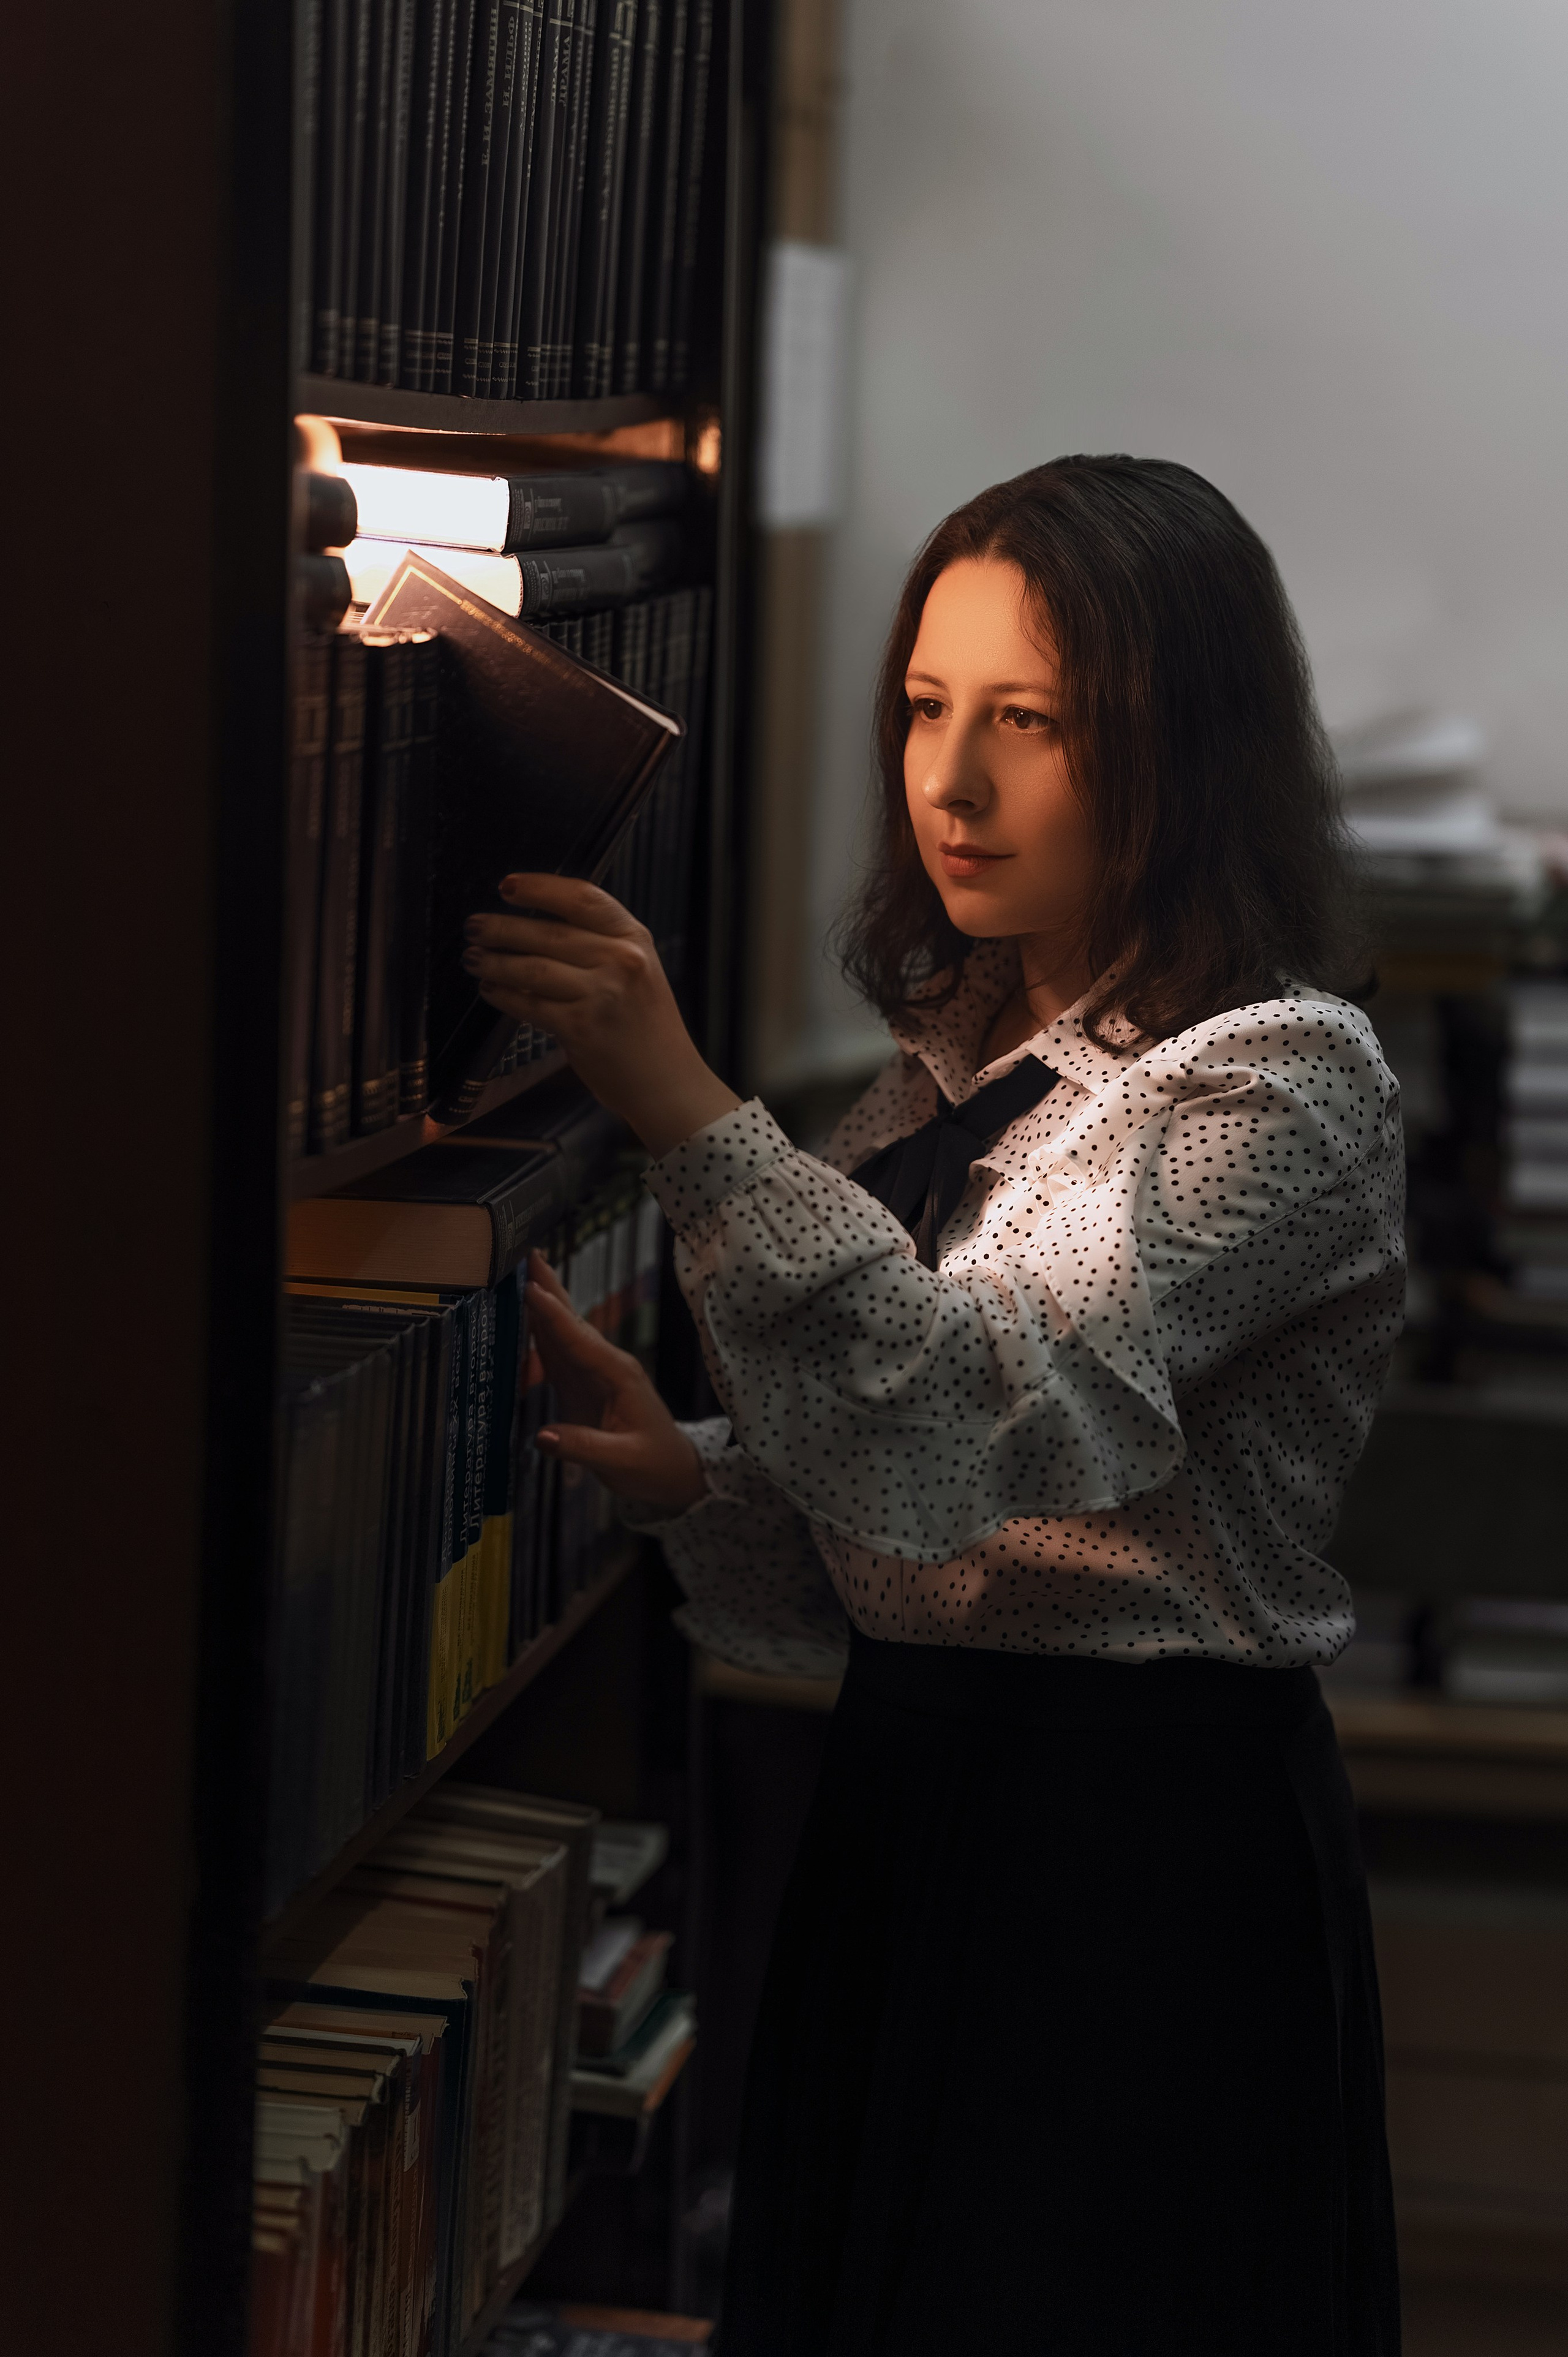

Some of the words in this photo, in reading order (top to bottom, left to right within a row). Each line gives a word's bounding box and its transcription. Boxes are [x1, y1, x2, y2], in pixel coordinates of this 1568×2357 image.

[484, 7, 497, 113] ЗАМЯТИН
[503, 16, 515, 79] ИЛЬФ
[530, 27, 542, 130] ТУРГЕНЕВ
[558, 36, 571, 108] ДРАМА
[502, 85, 511, 107] И.
[478, 1299, 489, 1382] второй
[460, 1403, 475, 1542] Литература
[469, 1310, 478, 1395] второй
[470, 1390, 487, 1529] Литература
